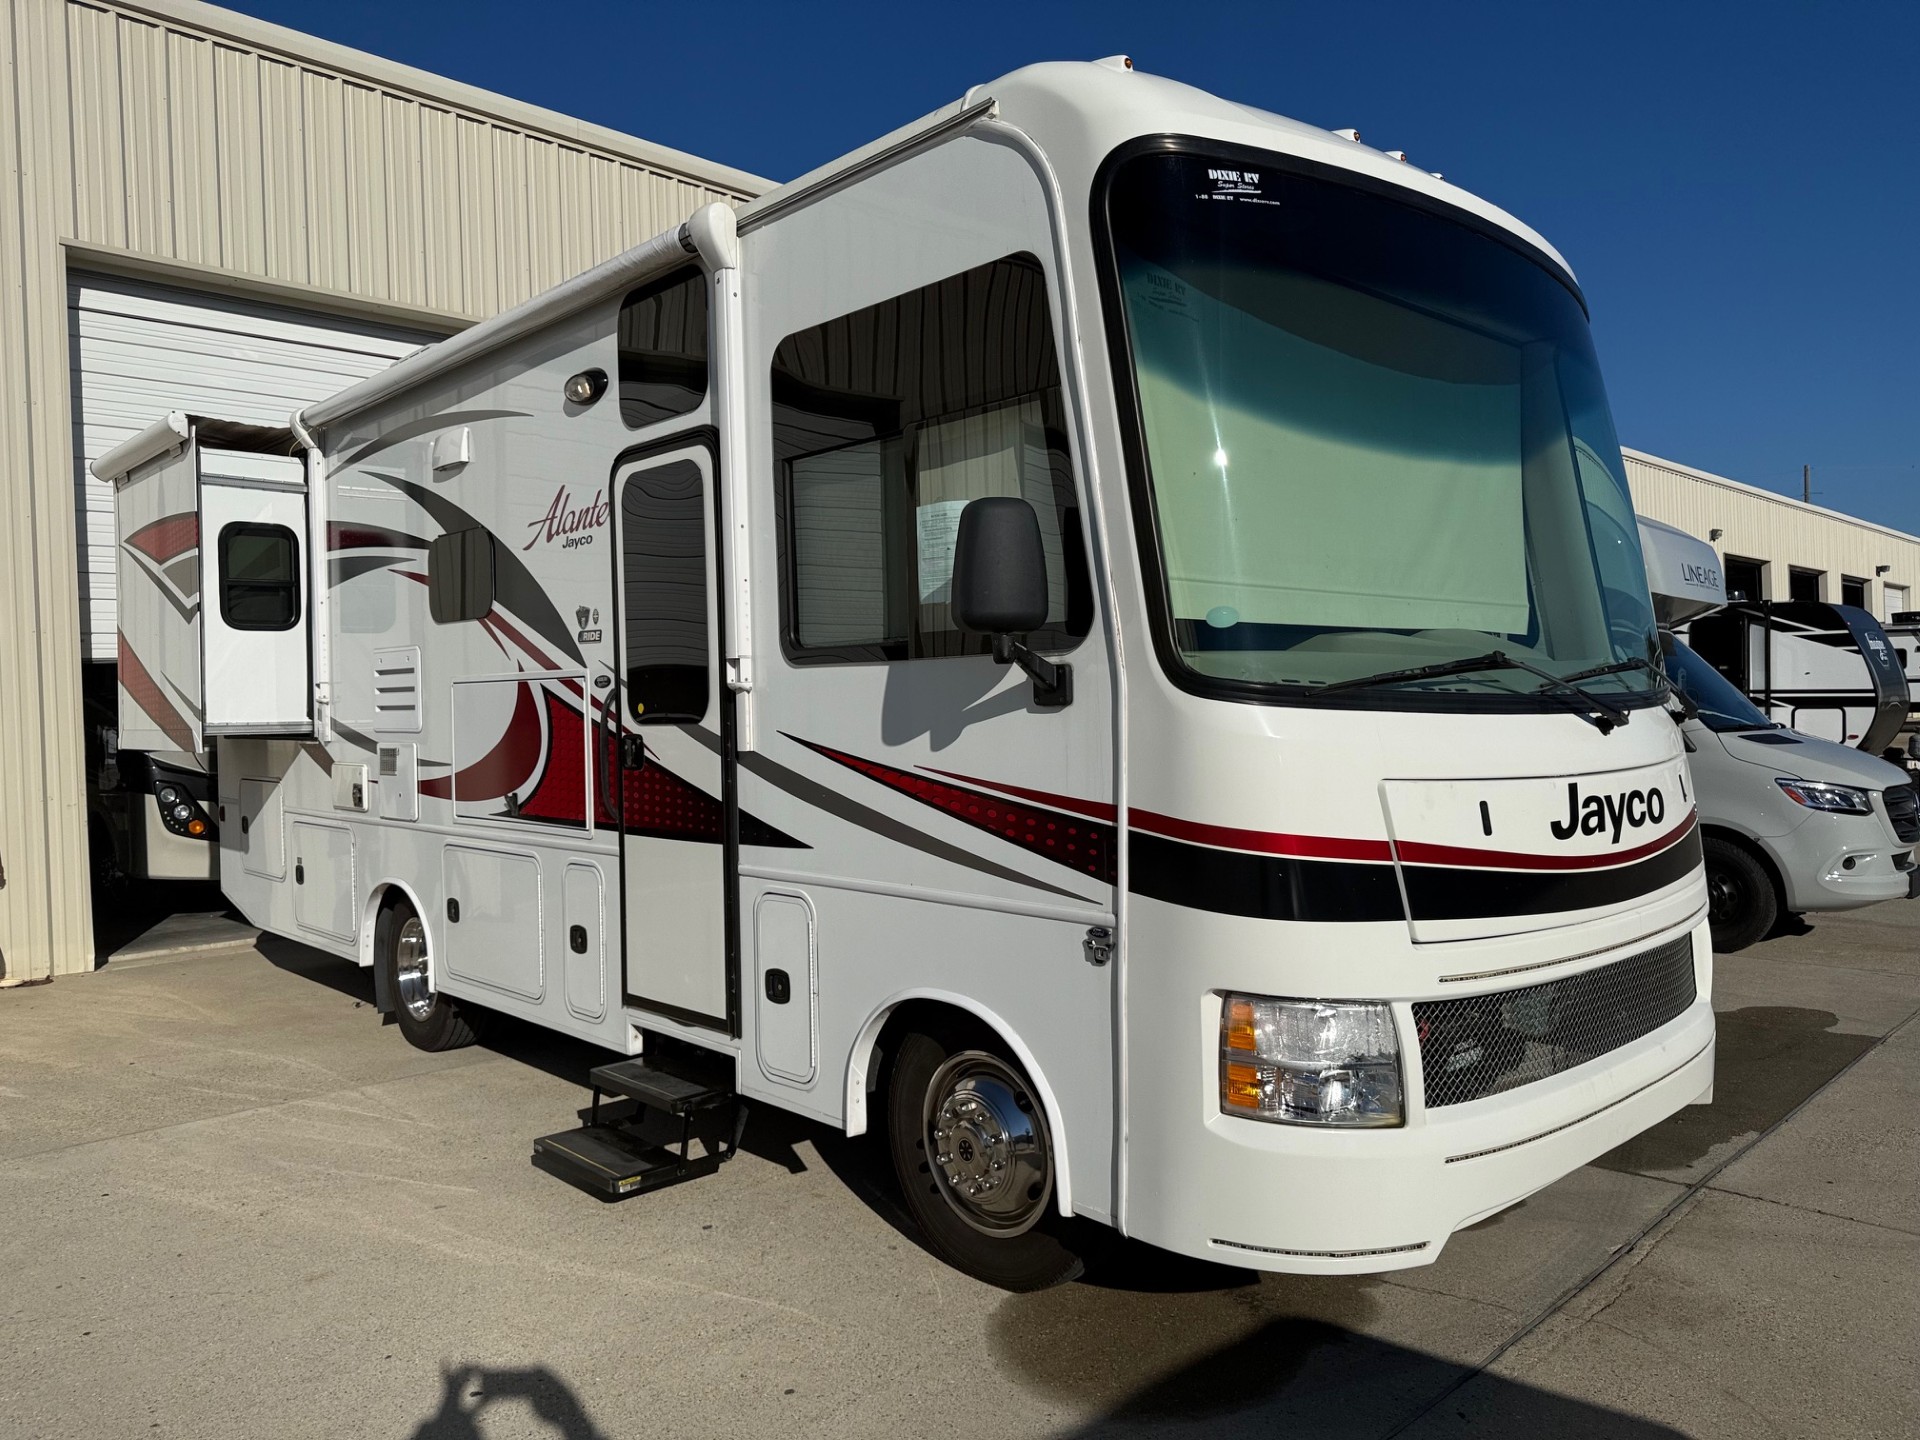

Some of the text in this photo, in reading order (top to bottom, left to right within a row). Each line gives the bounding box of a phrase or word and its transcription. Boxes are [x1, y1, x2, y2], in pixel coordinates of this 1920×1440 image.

[1208, 168, 1260, 184] DIXIE RV
[1217, 180, 1235, 189] Super
[523, 484, 610, 551] Alante
[562, 534, 593, 549] Jayco
[1681, 562, 1719, 588] LINEAGE
[1550, 782, 1665, 845] Jayco
